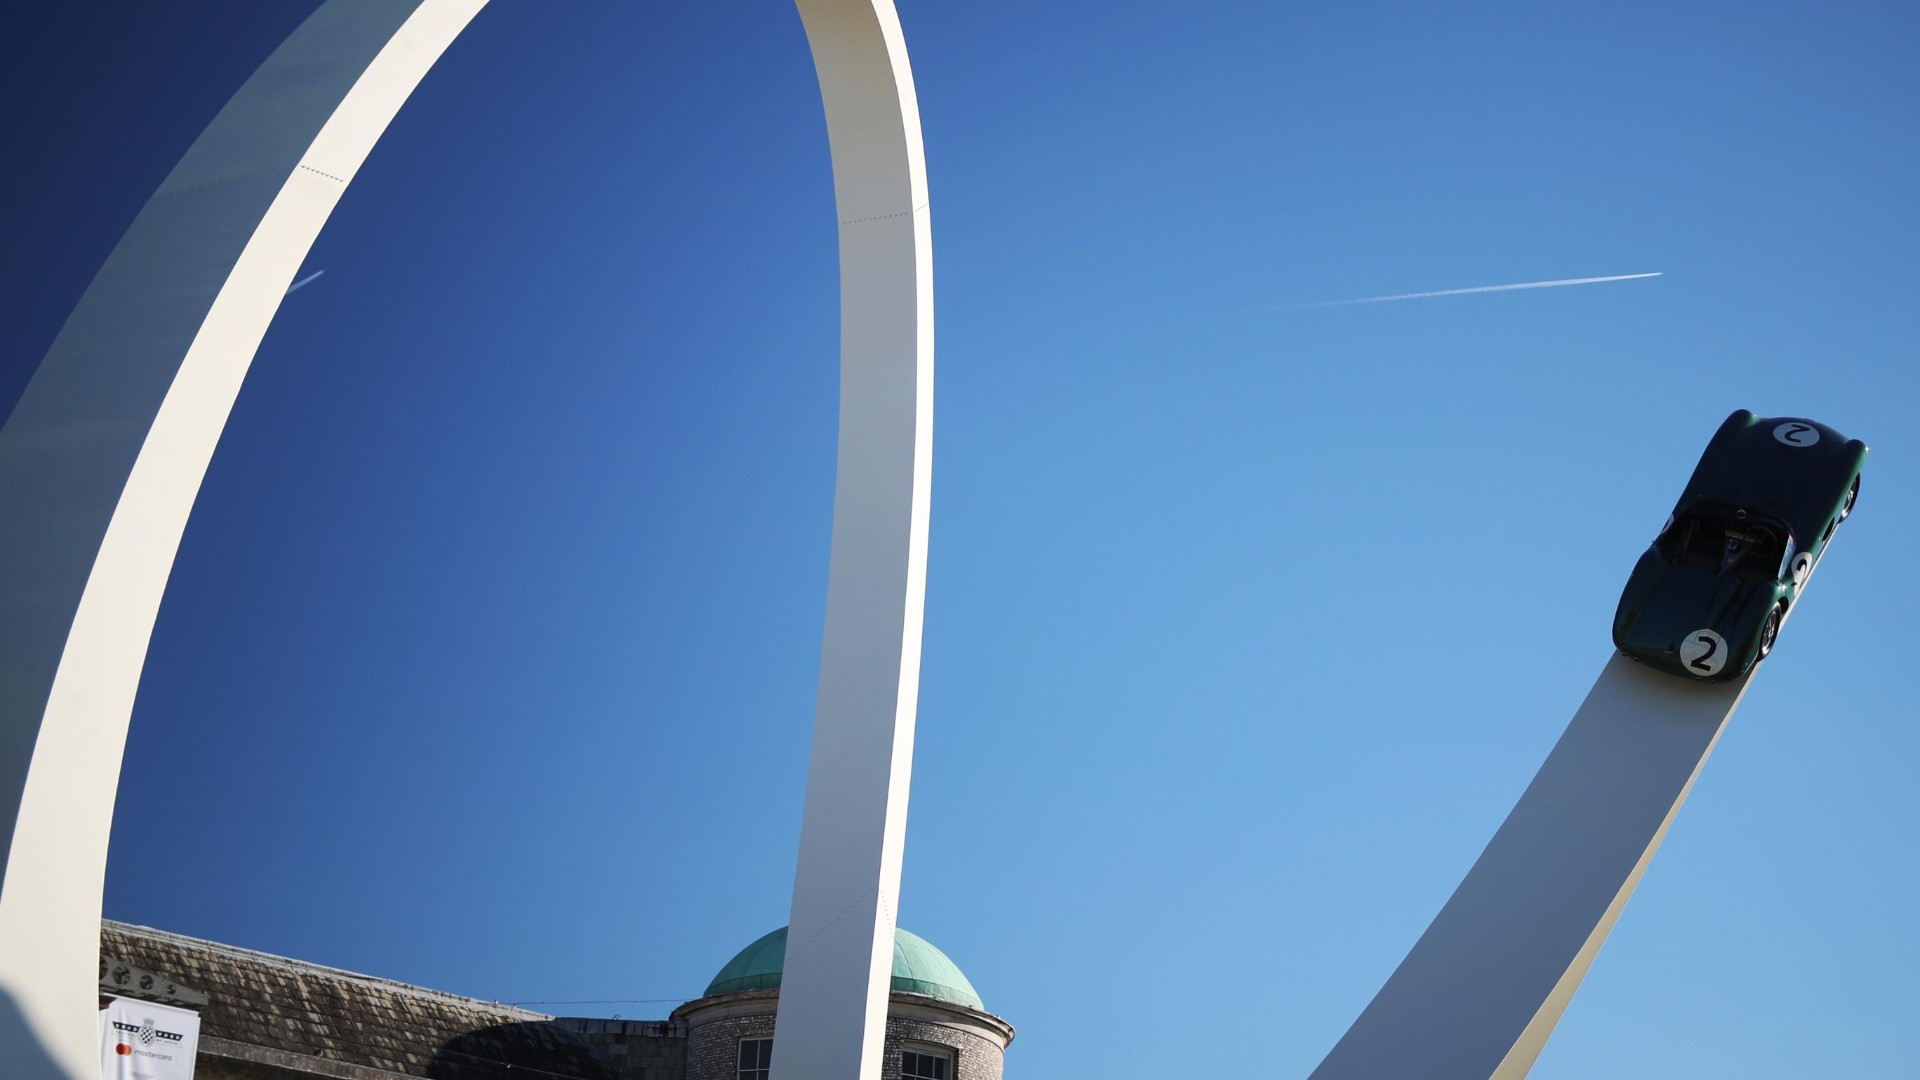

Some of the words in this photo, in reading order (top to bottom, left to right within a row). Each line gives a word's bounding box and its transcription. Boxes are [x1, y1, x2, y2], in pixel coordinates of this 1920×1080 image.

[1784, 424, 1810, 443] 2
[1690, 636, 1717, 671] 2
[134, 1049, 173, 1061] mastercard
